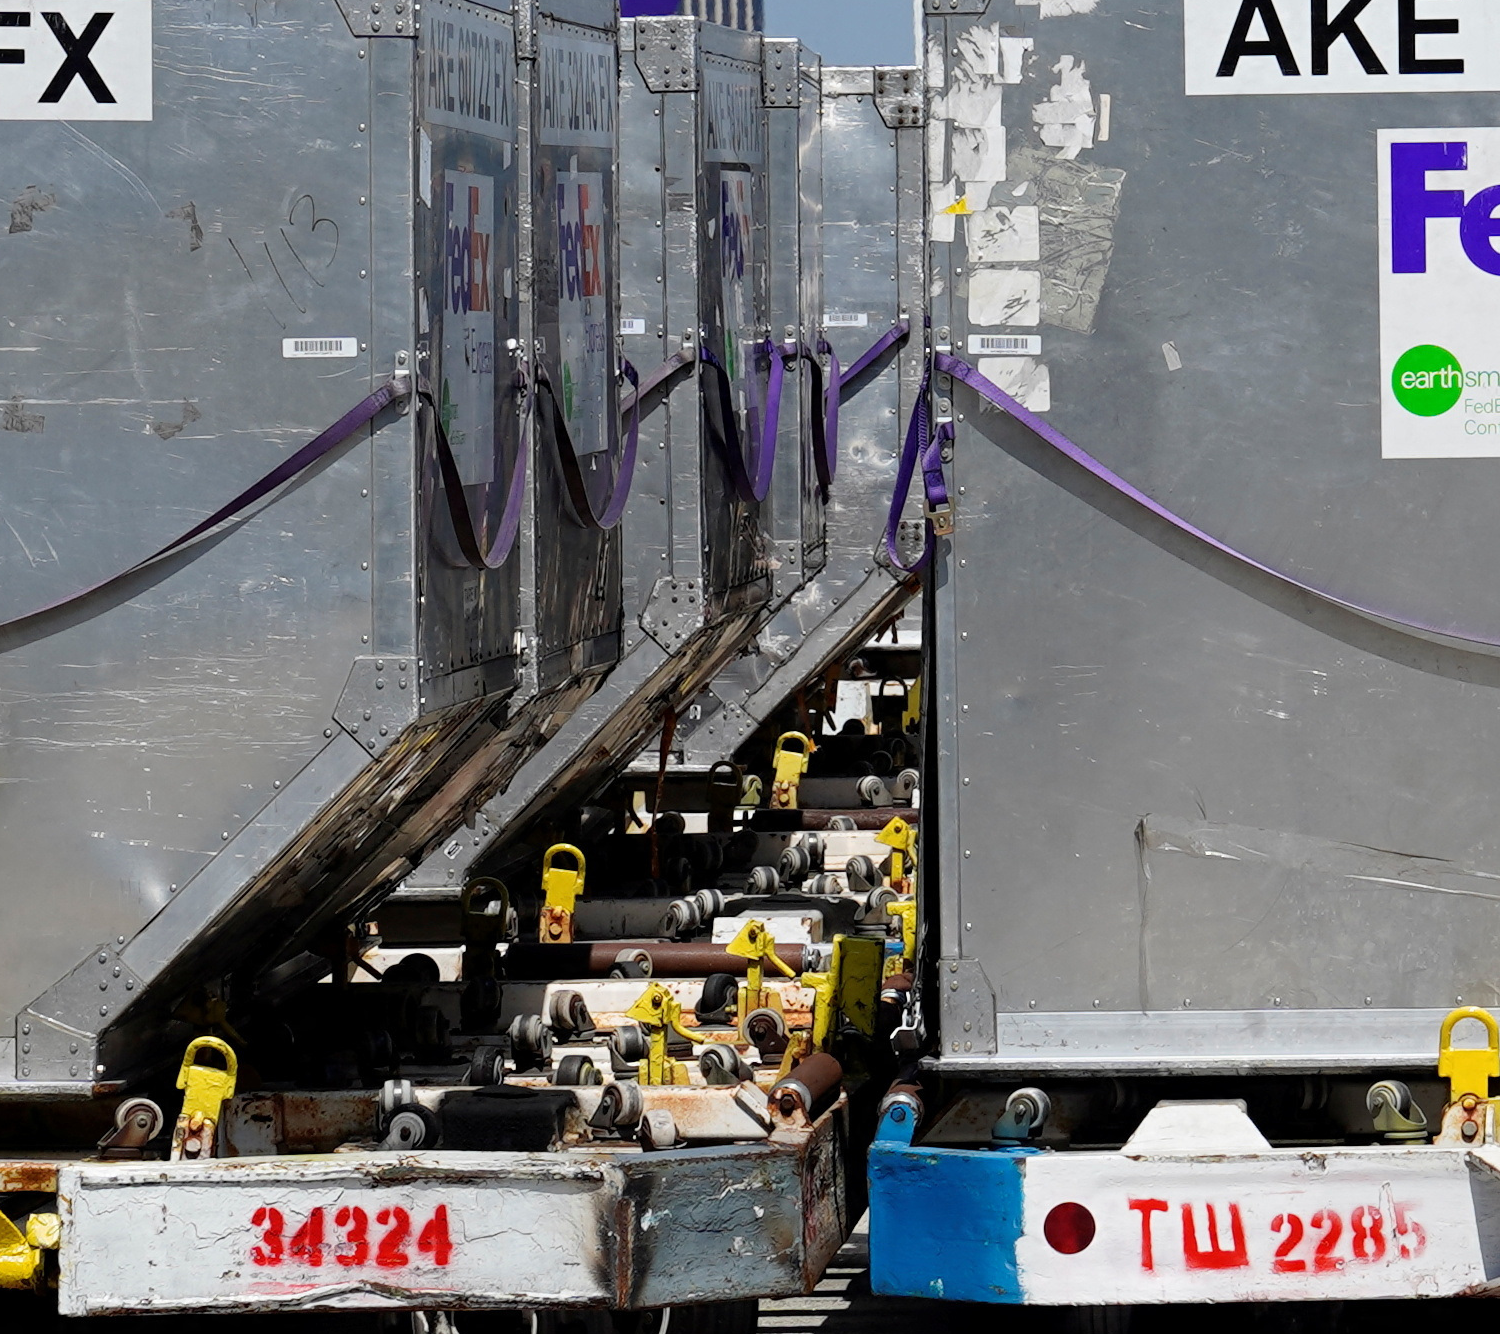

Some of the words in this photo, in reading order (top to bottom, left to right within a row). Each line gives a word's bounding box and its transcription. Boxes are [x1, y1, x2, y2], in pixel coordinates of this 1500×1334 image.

[428, 18, 455, 113] AKE
[458, 26, 491, 122] 60722
[494, 38, 510, 128] FX
[543, 47, 564, 130] AKE
[445, 181, 490, 315] FedEx
[557, 183, 602, 302] FedEx
[250, 1204, 453, 1269] 34324
[1269, 1199, 1428, 1275] 2285
